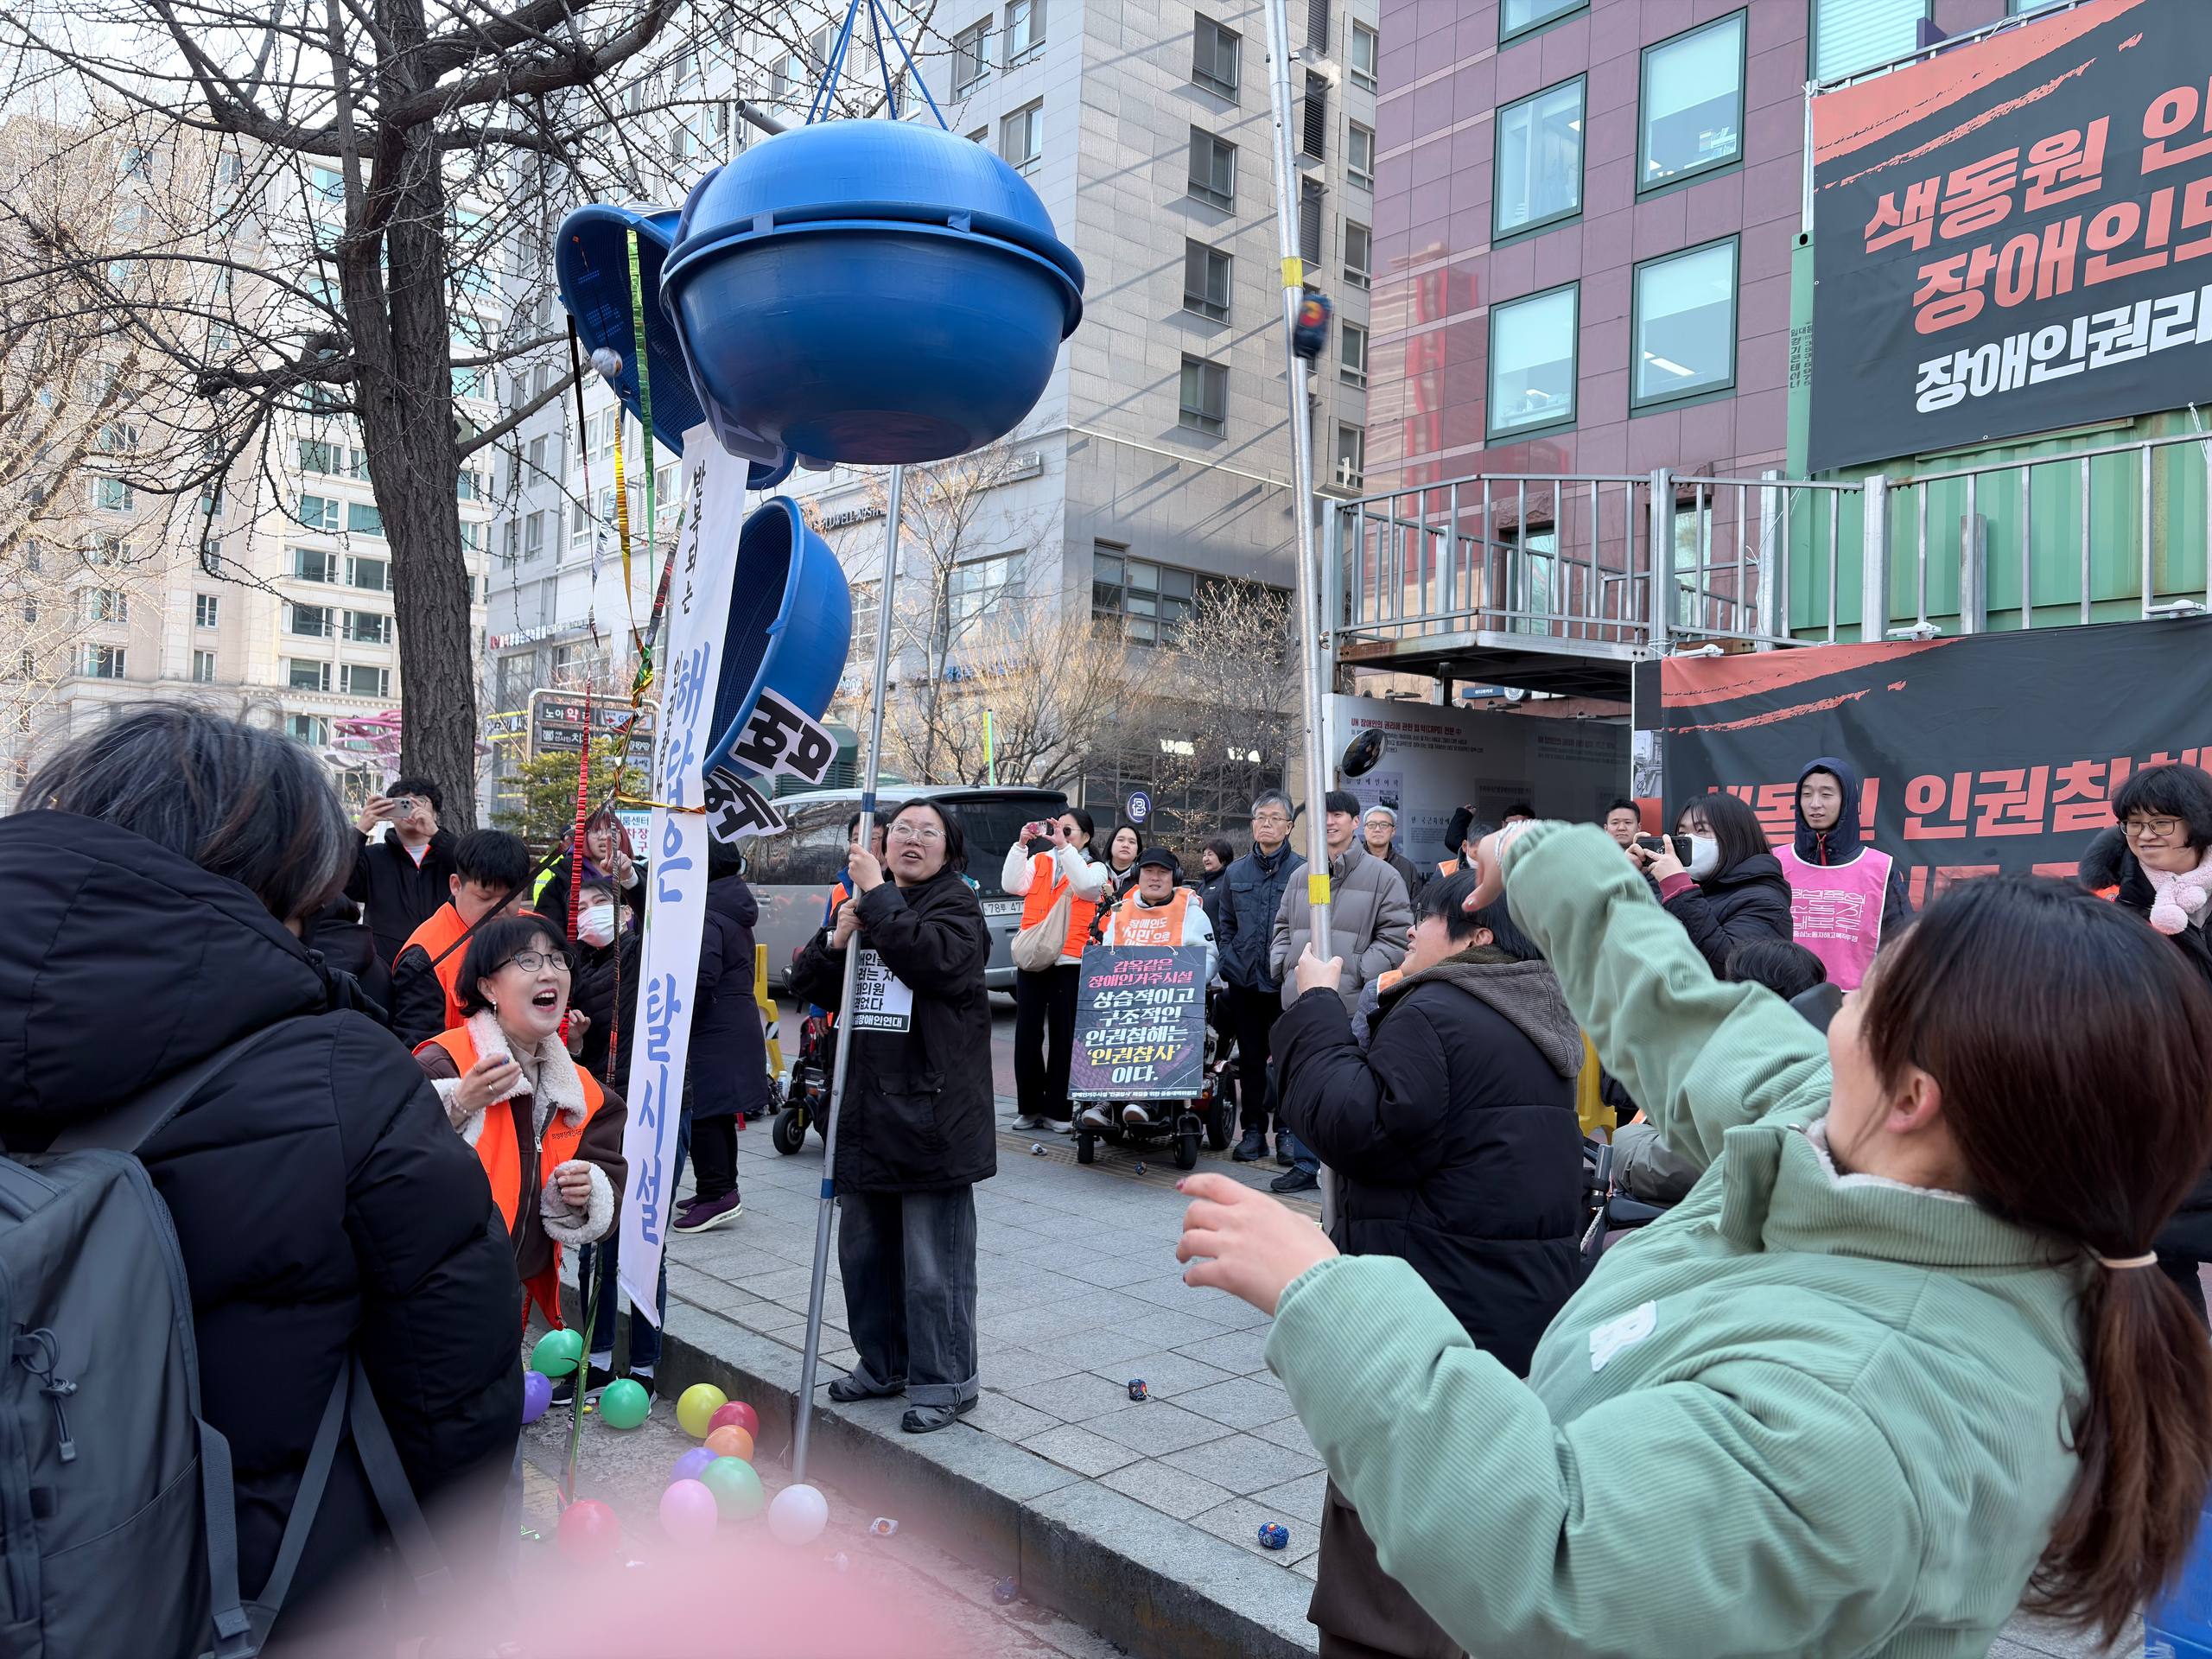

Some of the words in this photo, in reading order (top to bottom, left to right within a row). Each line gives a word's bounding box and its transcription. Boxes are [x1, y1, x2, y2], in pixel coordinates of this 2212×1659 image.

[1865, 116, 2110, 253] 색동원
[683, 459, 707, 615] 반복되는
[546, 707, 590, 722] 노아약
[658, 641, 711, 904] 해답은
[1129, 917, 1168, 929] 장애인도
[1113, 957, 1173, 973] 감옥같은
[1088, 969, 1193, 988] 장애인거주시설
[1093, 988, 1195, 1009] 상습적이고
[1099, 1006, 1181, 1027] 구조적인
[1085, 1026, 1189, 1047] 인권침해는
[1111, 1065, 1159, 1084] 이다.
[636, 973, 681, 1245] 탈시설
